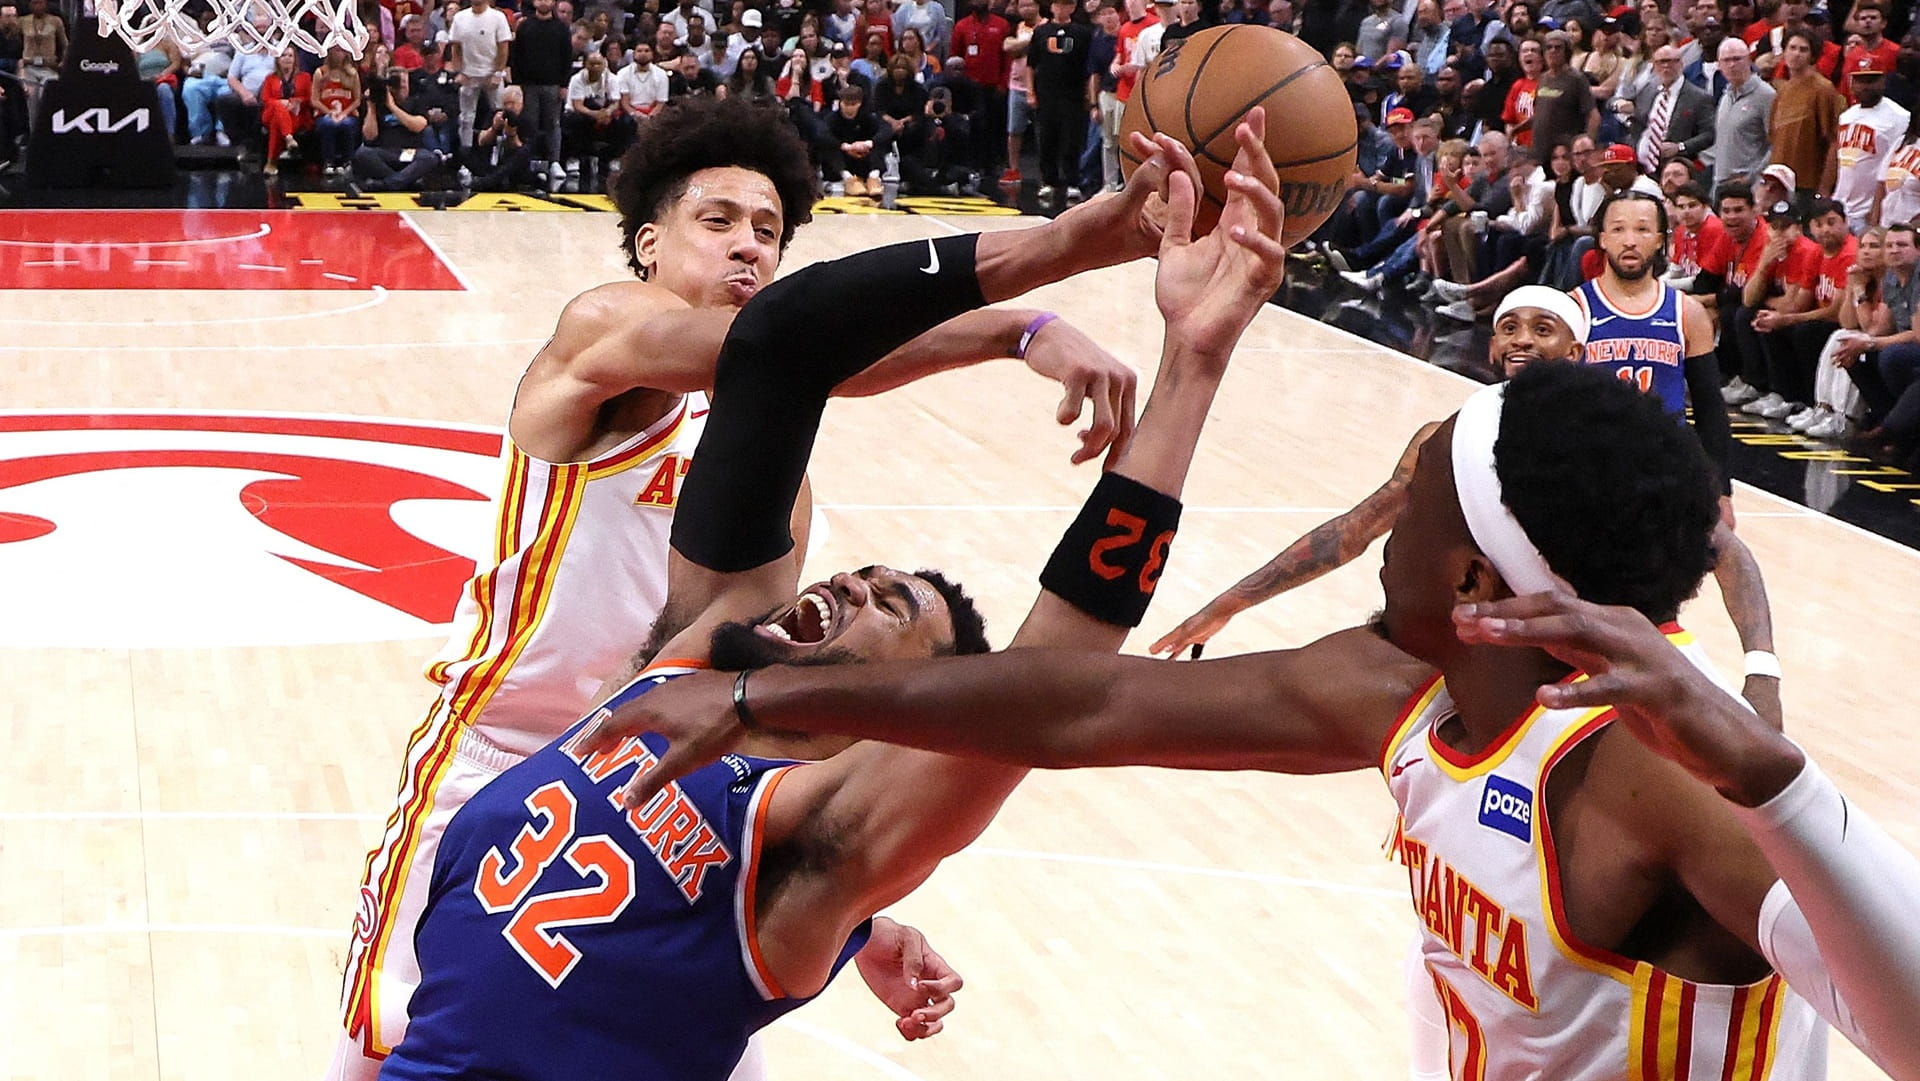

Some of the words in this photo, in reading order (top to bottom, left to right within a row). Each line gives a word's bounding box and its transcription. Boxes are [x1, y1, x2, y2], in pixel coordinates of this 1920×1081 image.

[80, 59, 119, 74] Google
[51, 107, 150, 133] KIA
[1586, 338, 1632, 364] NEW
[1633, 338, 1681, 367] YORK
[1484, 788, 1530, 824] paze
[473, 779, 636, 990] 32
